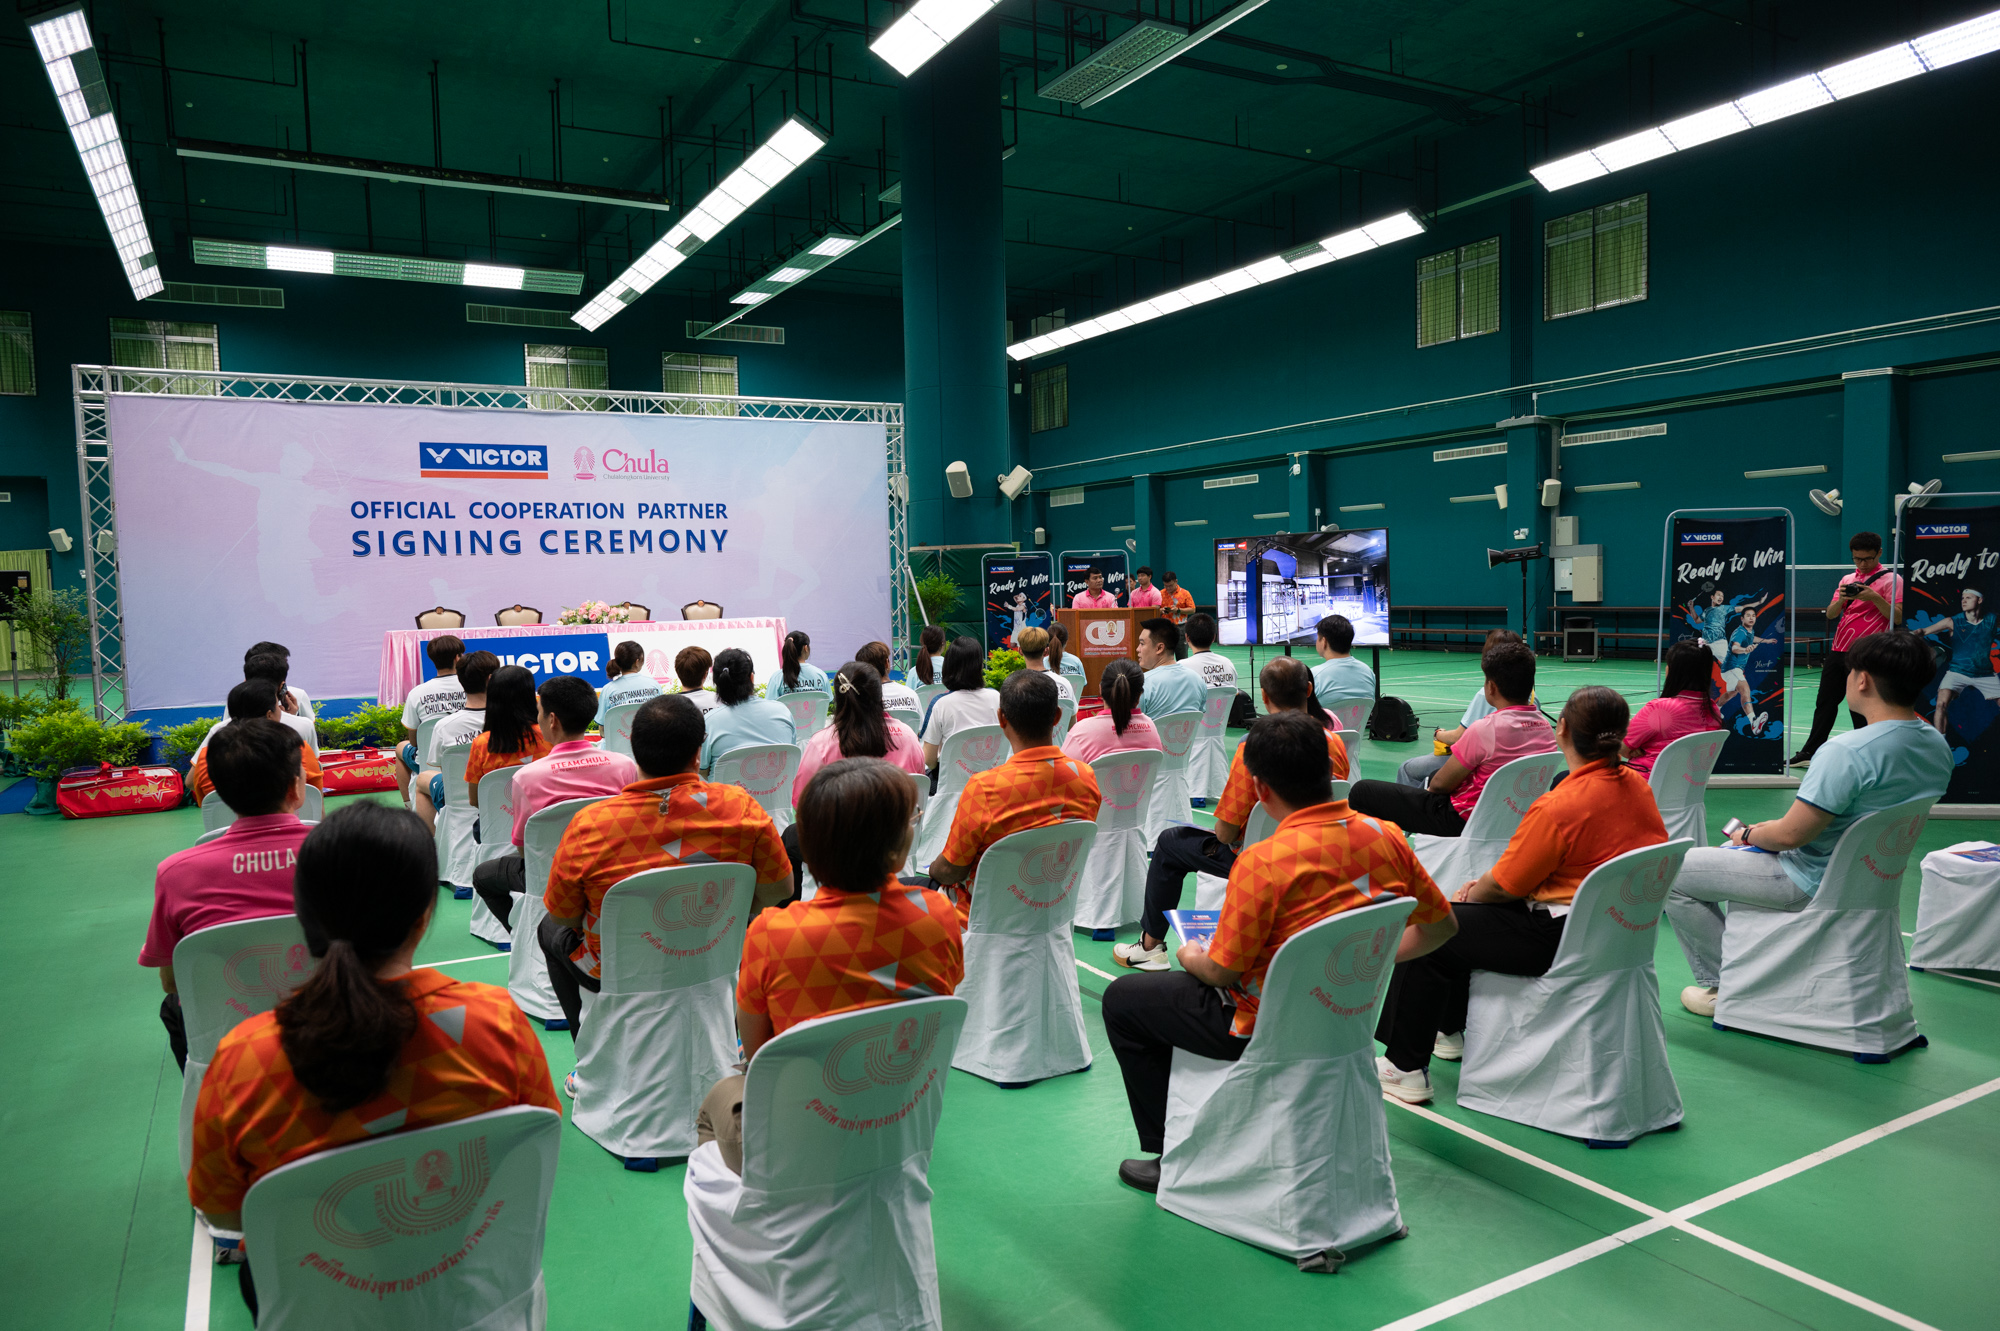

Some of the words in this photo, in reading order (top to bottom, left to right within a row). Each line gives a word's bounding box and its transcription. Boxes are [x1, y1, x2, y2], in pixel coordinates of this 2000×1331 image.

[456, 448, 542, 466] VICTOR
[602, 448, 670, 474] Chula
[603, 473, 642, 481] Chulalongkorn
[350, 501, 456, 519] OFFICIAL
[469, 501, 625, 520] COOPERATION
[637, 503, 728, 520] PARTNER
[1931, 525, 1968, 533] VICTOR
[352, 530, 522, 557] SIGNING
[539, 529, 729, 555] CEREMONY
[1677, 558, 1725, 584] Ready
[1729, 553, 1747, 573] to
[1753, 547, 1784, 569] Win
[1911, 553, 1971, 583] Ready
[1977, 548, 1999, 570] to
[989, 579, 1016, 595] Ready
[1018, 577, 1028, 588] to
[1031, 573, 1048, 585] Win
[1107, 571, 1125, 584] Win
[1203, 664, 1224, 675] COACH
[420, 690, 467, 706] LAPBUMRUNGWO
[551, 756, 610, 770] #TEAMCHULA
[102, 784, 159, 798] VICTOR
